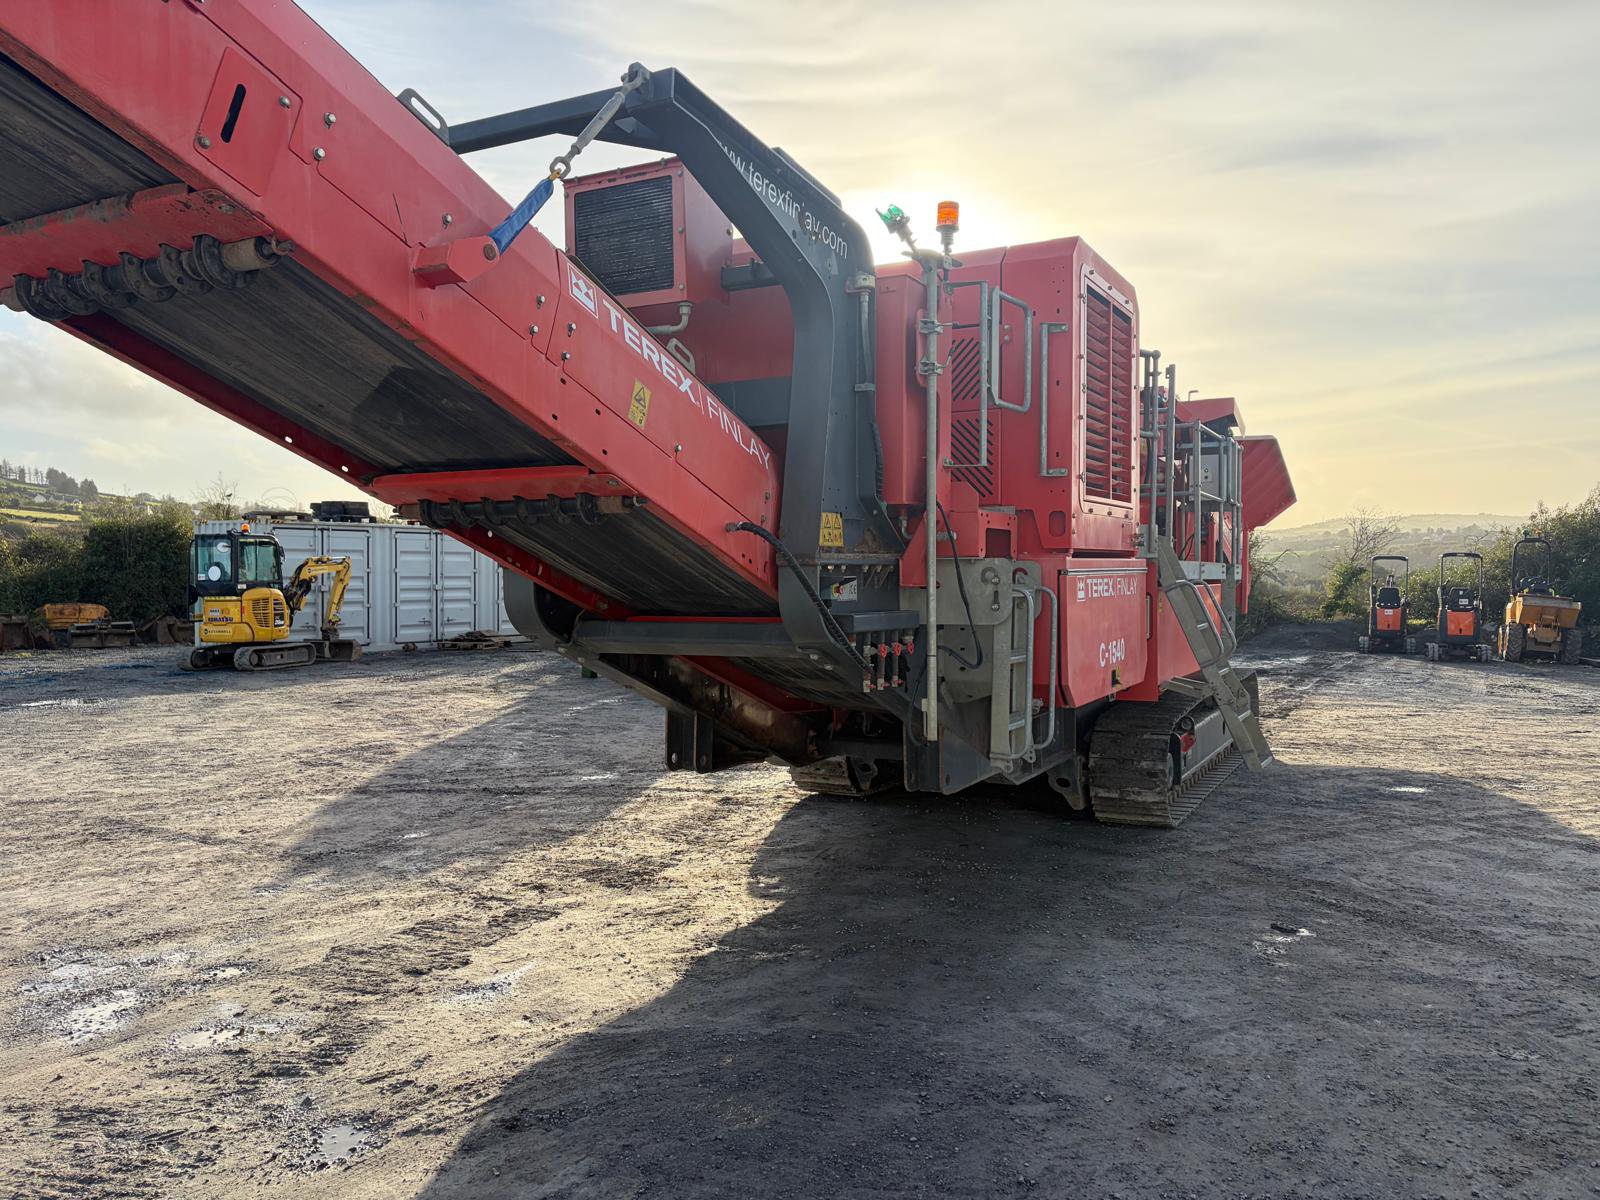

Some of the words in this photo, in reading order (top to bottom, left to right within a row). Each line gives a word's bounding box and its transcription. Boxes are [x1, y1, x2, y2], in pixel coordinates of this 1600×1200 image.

[602, 299, 698, 405] TEREX
[706, 395, 771, 470] FINLAY
[1087, 577, 1115, 598] TEREX
[1116, 576, 1138, 596] FINLAY
[1099, 637, 1125, 668] C-1540
